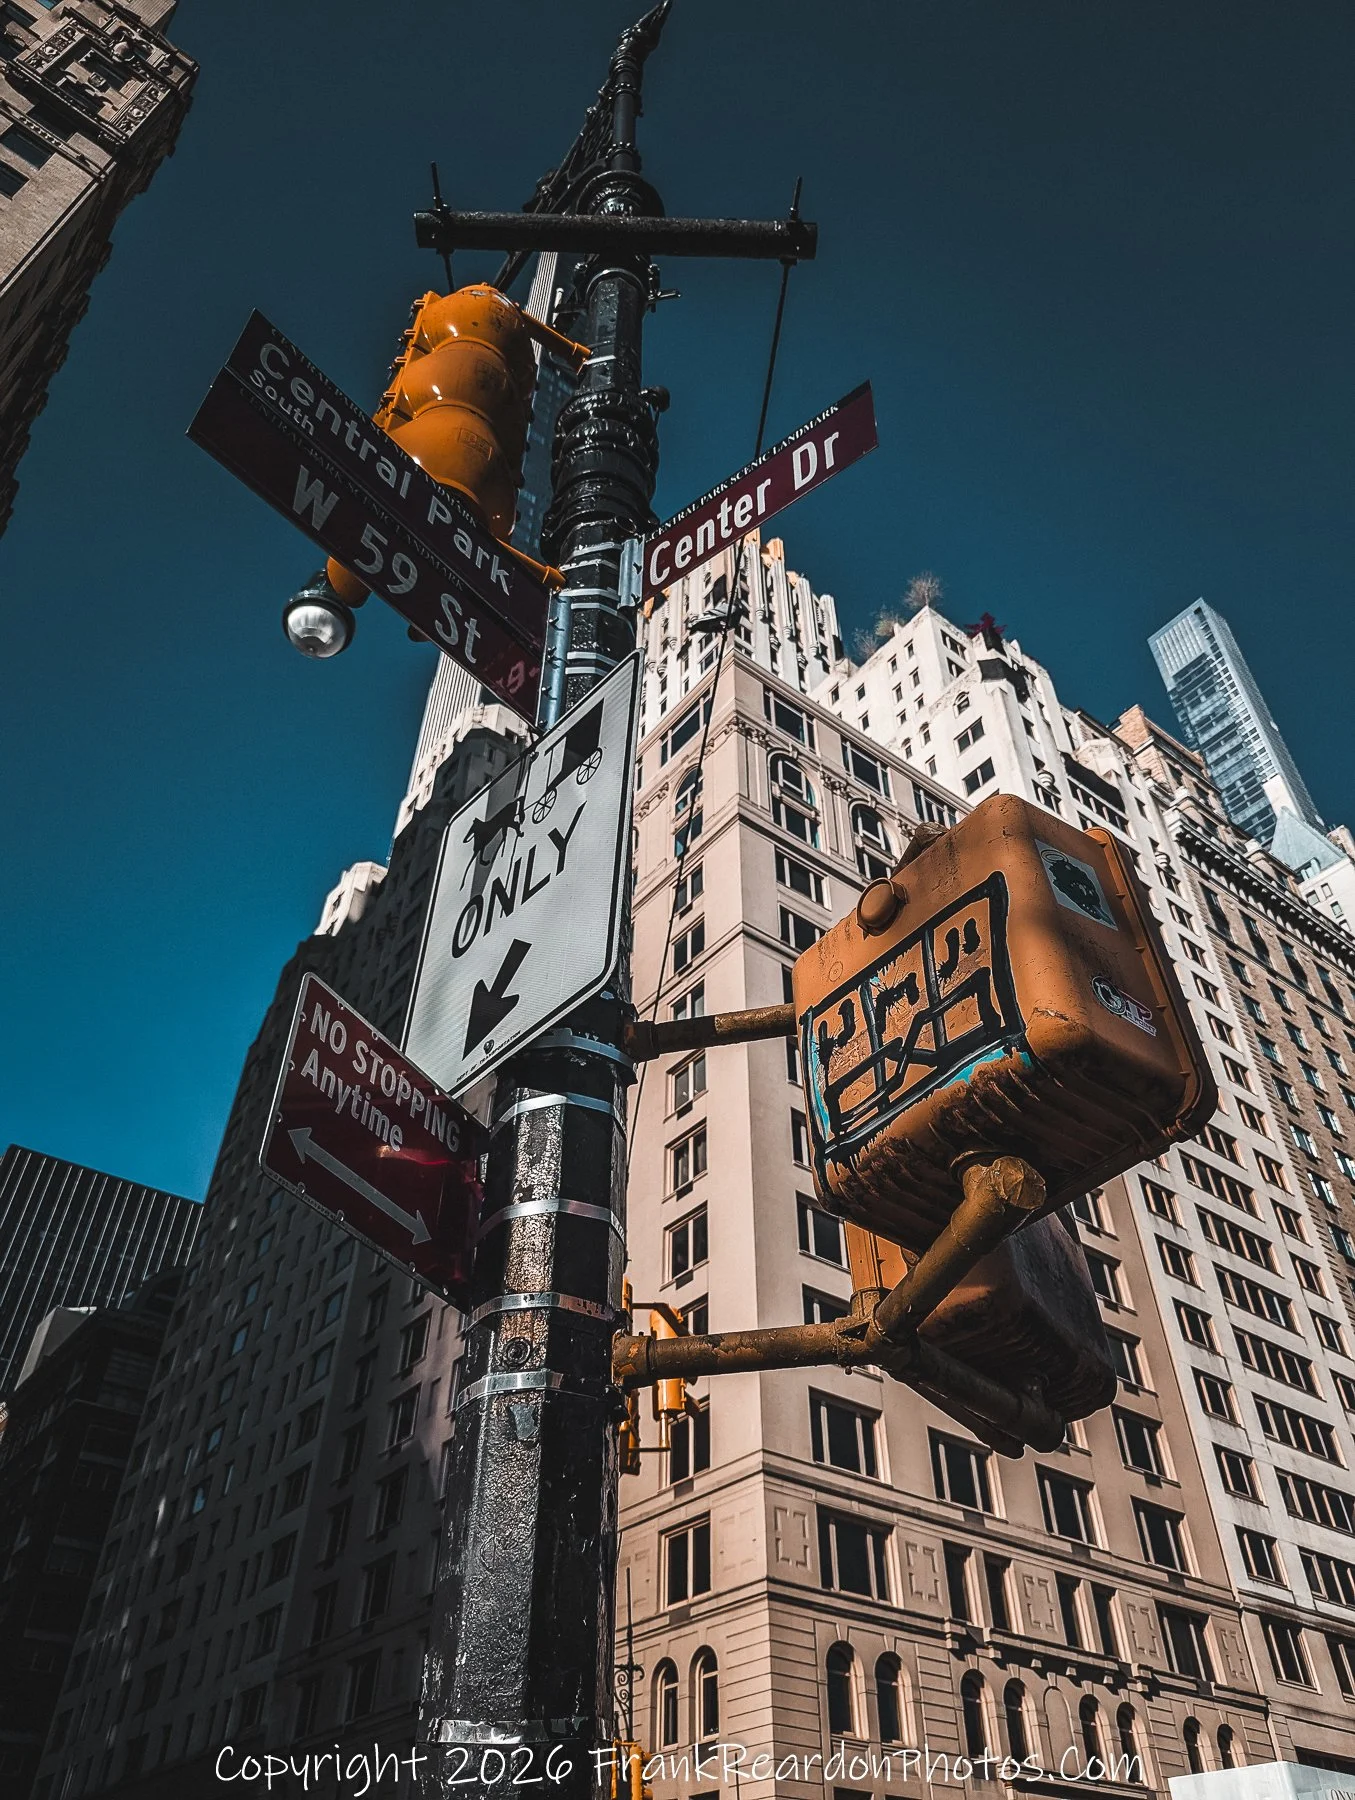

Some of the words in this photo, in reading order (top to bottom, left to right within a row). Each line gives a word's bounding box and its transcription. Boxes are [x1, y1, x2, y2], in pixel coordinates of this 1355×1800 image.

[249, 369, 316, 436] South
[259, 342, 411, 499] Central
[427, 496, 510, 596] Park
[650, 502, 700, 540] CENTRAL
[699, 480, 731, 505] PARK
[728, 451, 772, 485] SCENIC
[771, 403, 841, 455] LANDMARK
[292, 464, 340, 531] W
[354, 523, 418, 595] 59
[435, 593, 482, 664] St
[650, 478, 771, 586] Center
[792, 431, 839, 491] Dr
[452, 801, 588, 959] ONLY
[300, 1048, 403, 1152] Anytime
[310, 1002, 347, 1054] NO
[352, 1040, 461, 1153] STOPPING
